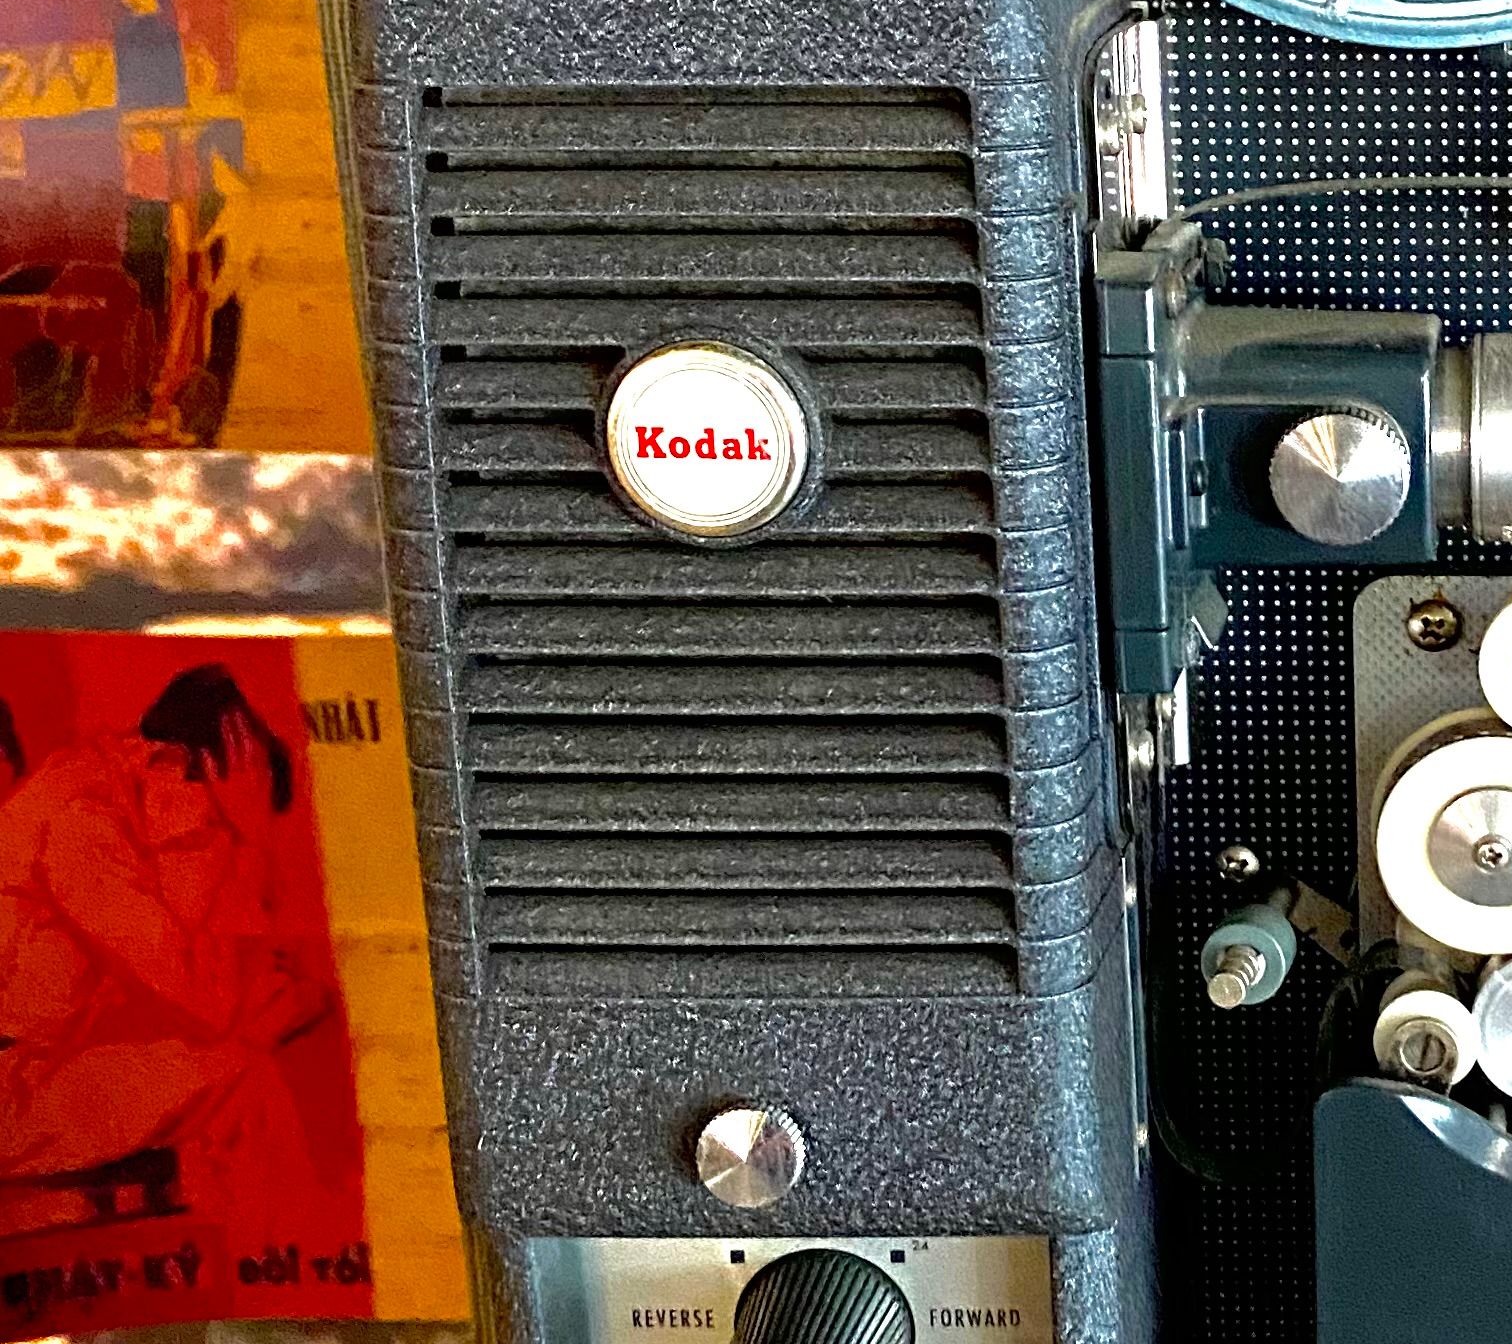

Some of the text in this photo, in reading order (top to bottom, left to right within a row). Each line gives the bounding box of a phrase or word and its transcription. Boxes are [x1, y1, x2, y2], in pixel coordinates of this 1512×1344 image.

[635, 426, 772, 460] Kodak
[631, 1308, 717, 1329] REVERSE
[929, 1308, 1022, 1329] FORWARD
